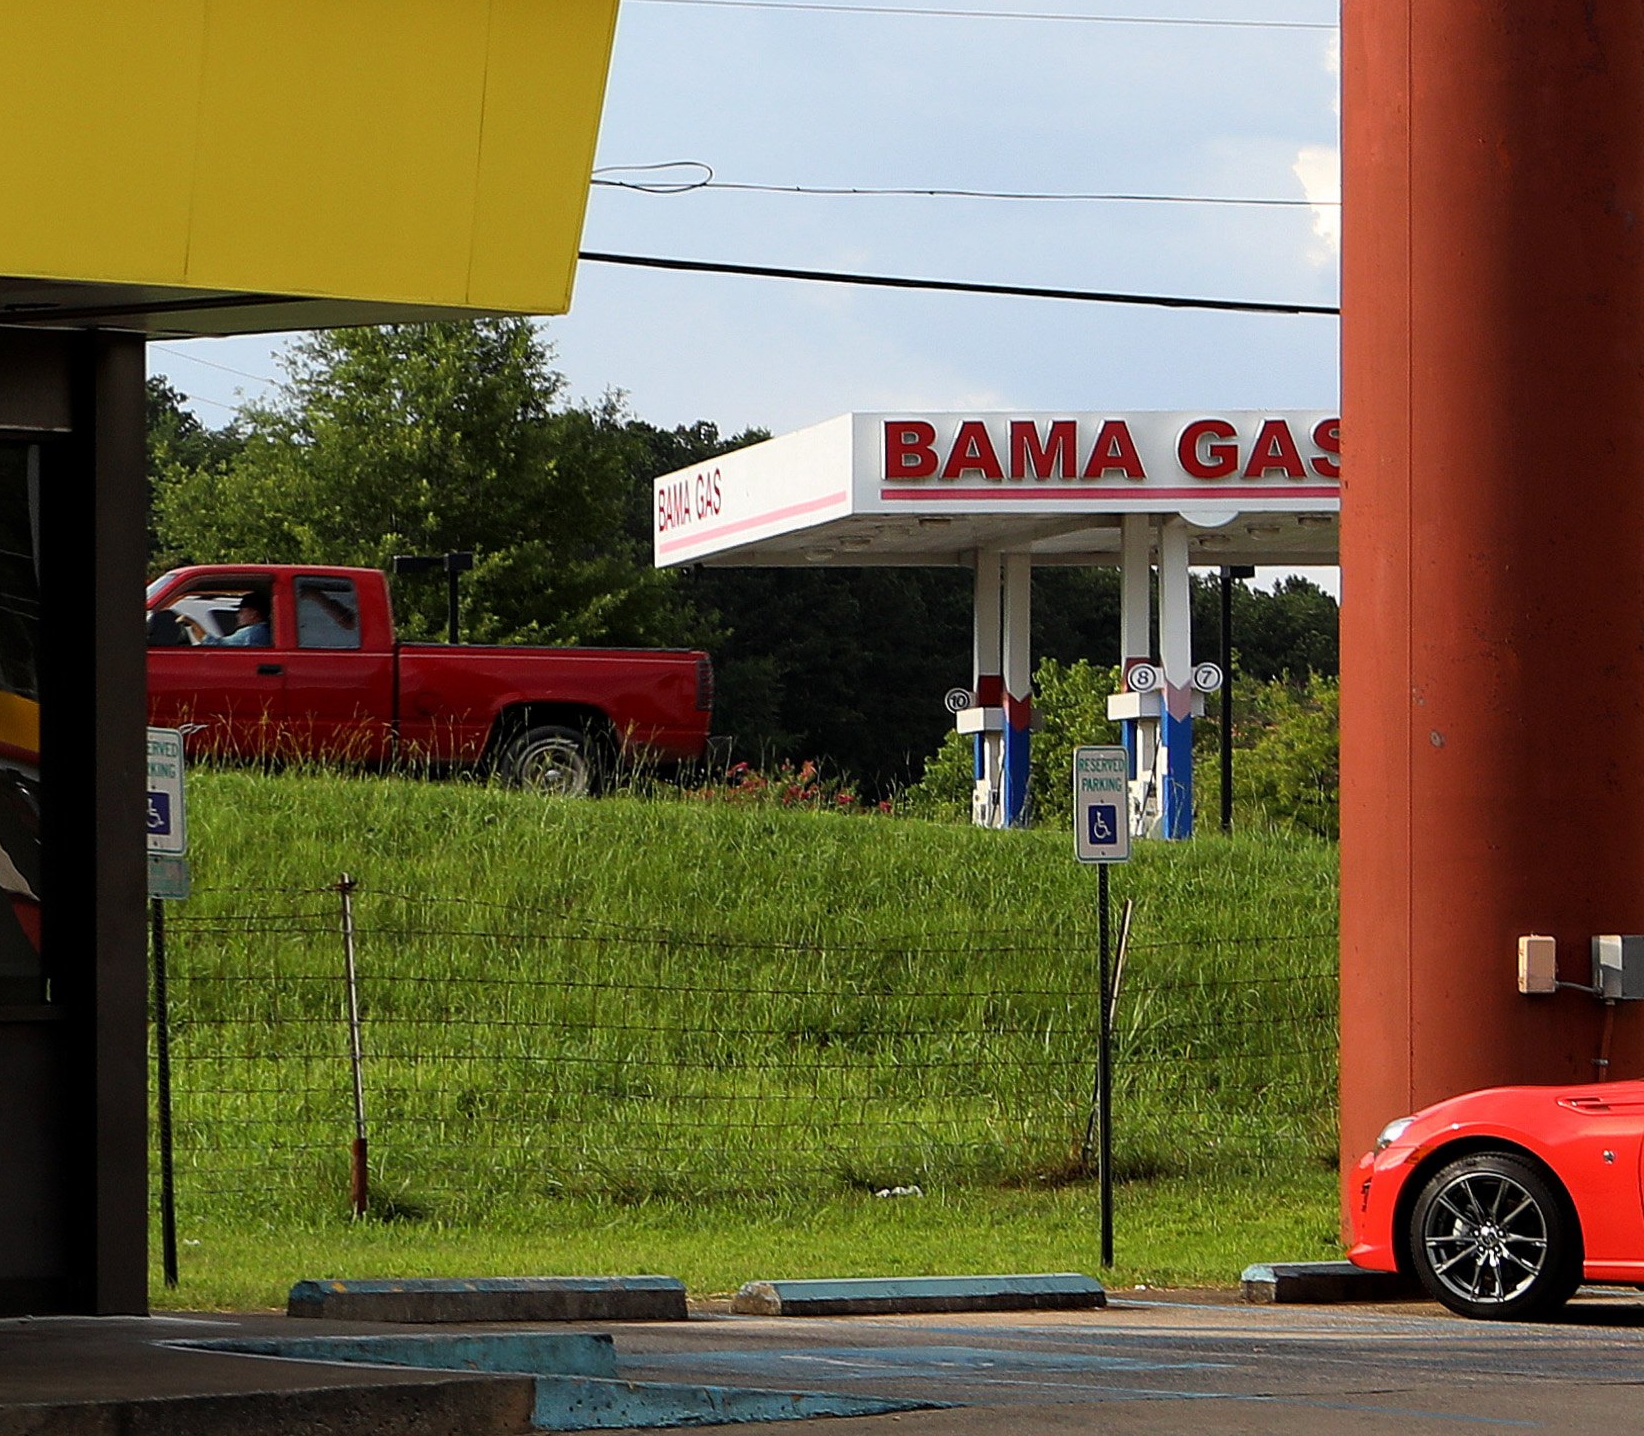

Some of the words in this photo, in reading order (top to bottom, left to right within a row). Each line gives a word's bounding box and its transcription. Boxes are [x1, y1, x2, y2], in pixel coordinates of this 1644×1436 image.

[881, 418, 1148, 480] BAMA
[1176, 417, 1341, 480] GAS
[658, 478, 692, 532] BAMA
[696, 468, 721, 520] GAS
[1137, 670, 1149, 685] 8
[1201, 670, 1212, 685] 7
[949, 695, 966, 708] 10
[147, 741, 179, 757] ERVED
[1077, 757, 1126, 773] RESERVED
[1081, 777, 1122, 792] PARKING
